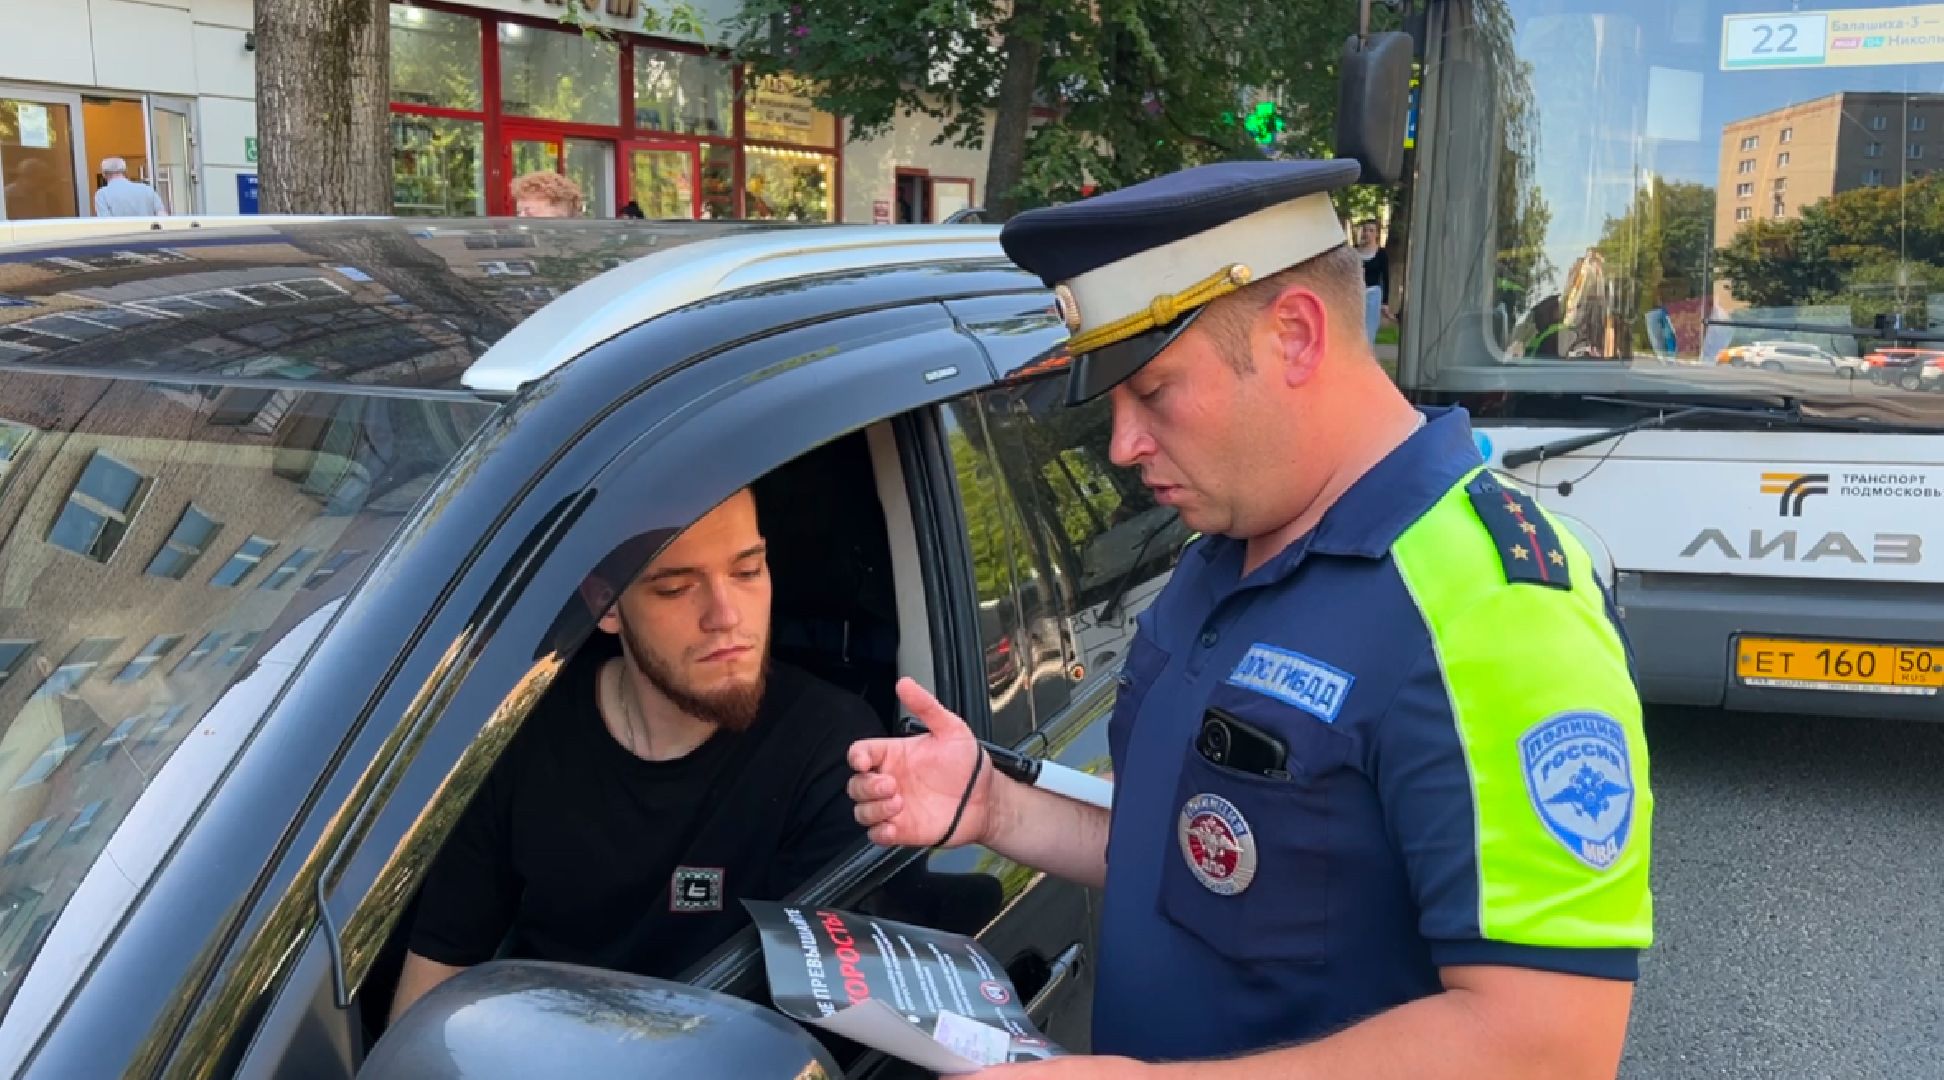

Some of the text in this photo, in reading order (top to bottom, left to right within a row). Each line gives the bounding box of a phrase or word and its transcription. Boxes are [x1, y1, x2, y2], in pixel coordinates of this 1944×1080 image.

[1751, 23, 1798, 54] 22
[1832, 15, 1919, 32] Балашиха-3
[1841, 487, 1944, 497] ПОДМОСКОВЬ
[1842, 474, 1926, 484] ТРАНСПОРТ
[1679, 528, 1922, 564] ЛИАЗ
[1815, 648, 1875, 677] 160
[1899, 651, 1932, 672] 50
[1902, 673, 1926, 682] RUS
[1272, 663, 1337, 711] ГИБДД
[1529, 719, 1622, 760] ПОЛИЦИЯ
[1542, 744, 1620, 782] РОССИЯ
[1582, 836, 1618, 866] МВД
